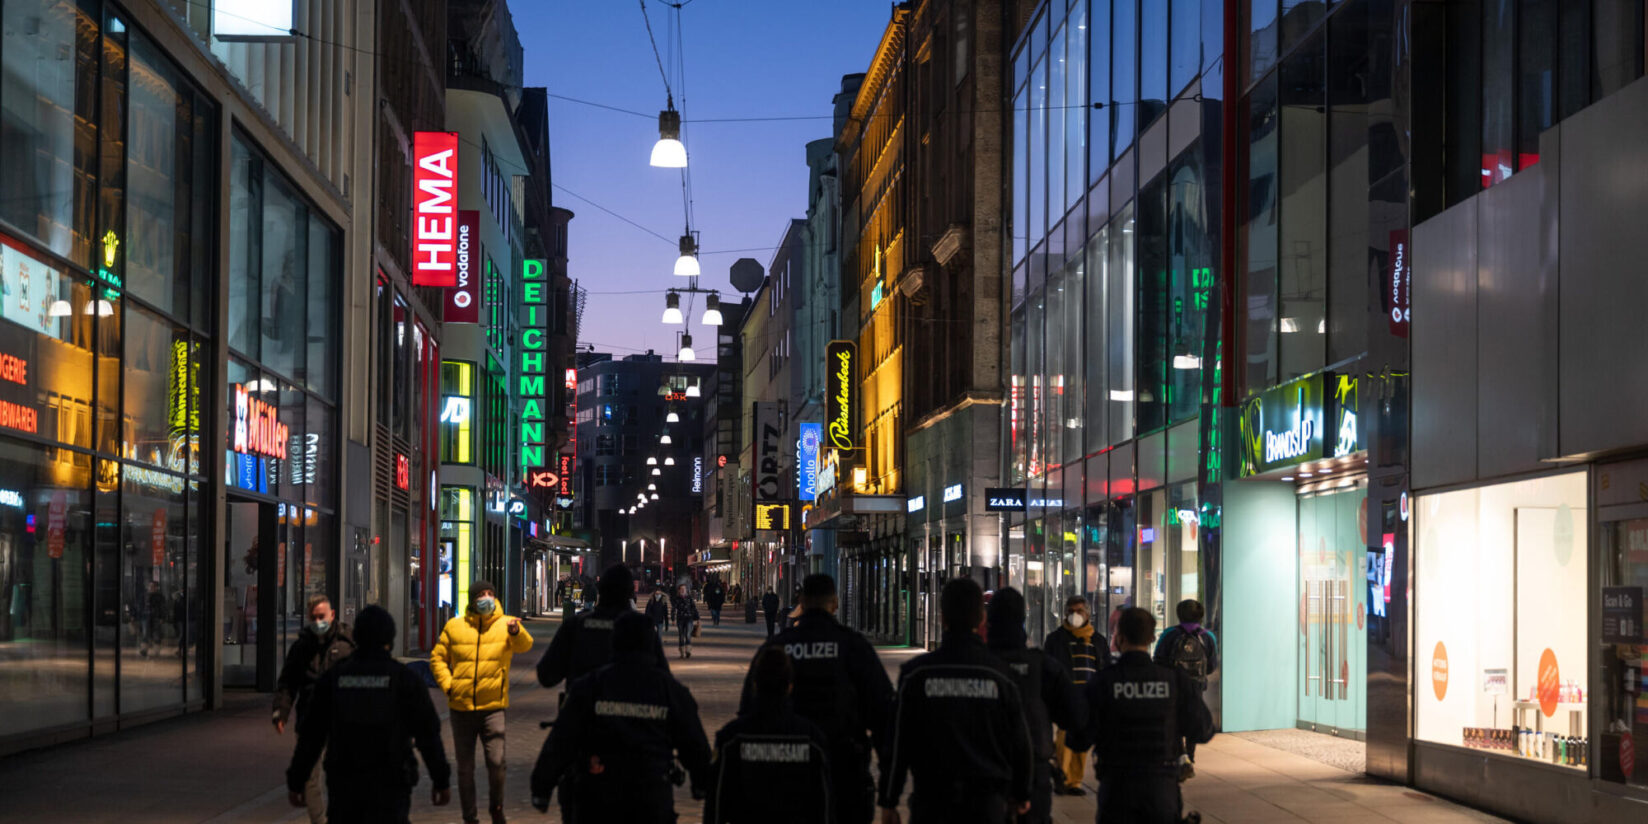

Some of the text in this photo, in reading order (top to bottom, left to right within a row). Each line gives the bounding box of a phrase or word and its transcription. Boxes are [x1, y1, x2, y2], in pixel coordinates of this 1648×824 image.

[417, 149, 453, 271] HEMA
[458, 225, 470, 289] vodafone
[0, 352, 27, 385] GERIE
[520, 259, 543, 466] DEICHMANN
[441, 396, 470, 423] JD
[248, 396, 288, 460] Müller
[805, 459, 815, 495] Apollo
[509, 501, 525, 513] JD
[989, 498, 1023, 507] ZARA
[783, 641, 839, 660] POLIZEI
[1112, 681, 1171, 700] POLIZEI
